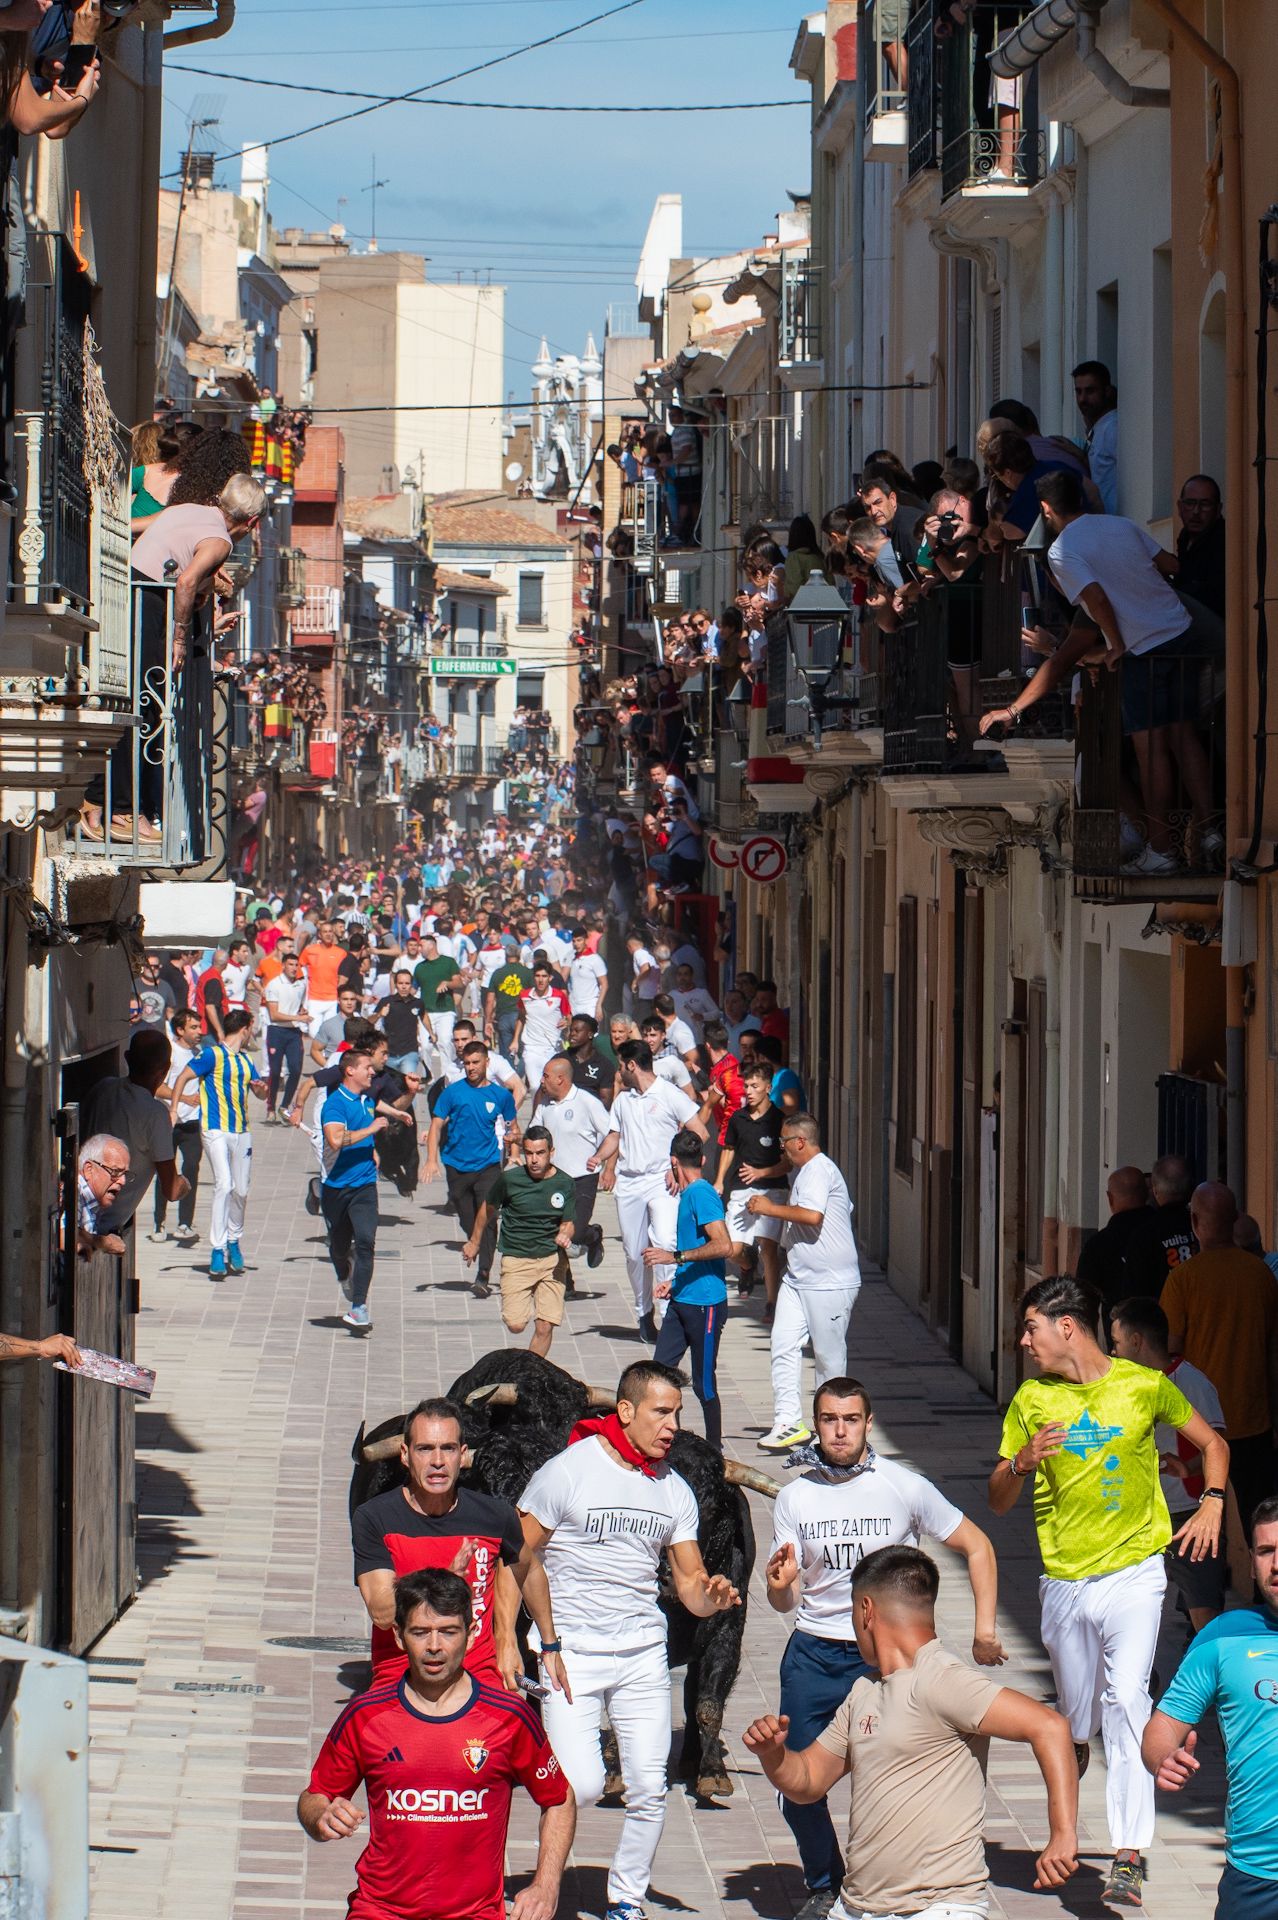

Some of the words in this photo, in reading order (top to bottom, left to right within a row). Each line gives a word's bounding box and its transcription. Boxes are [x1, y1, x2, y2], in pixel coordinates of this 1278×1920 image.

[436, 661, 498, 673] ENFERMERIA
[799, 1520, 838, 1540] MAITE
[842, 1518, 892, 1537] ZAITUT
[823, 1542, 865, 1570] AITA
[407, 1813, 459, 1823] Climatización
[459, 1812, 489, 1822] eficiente
